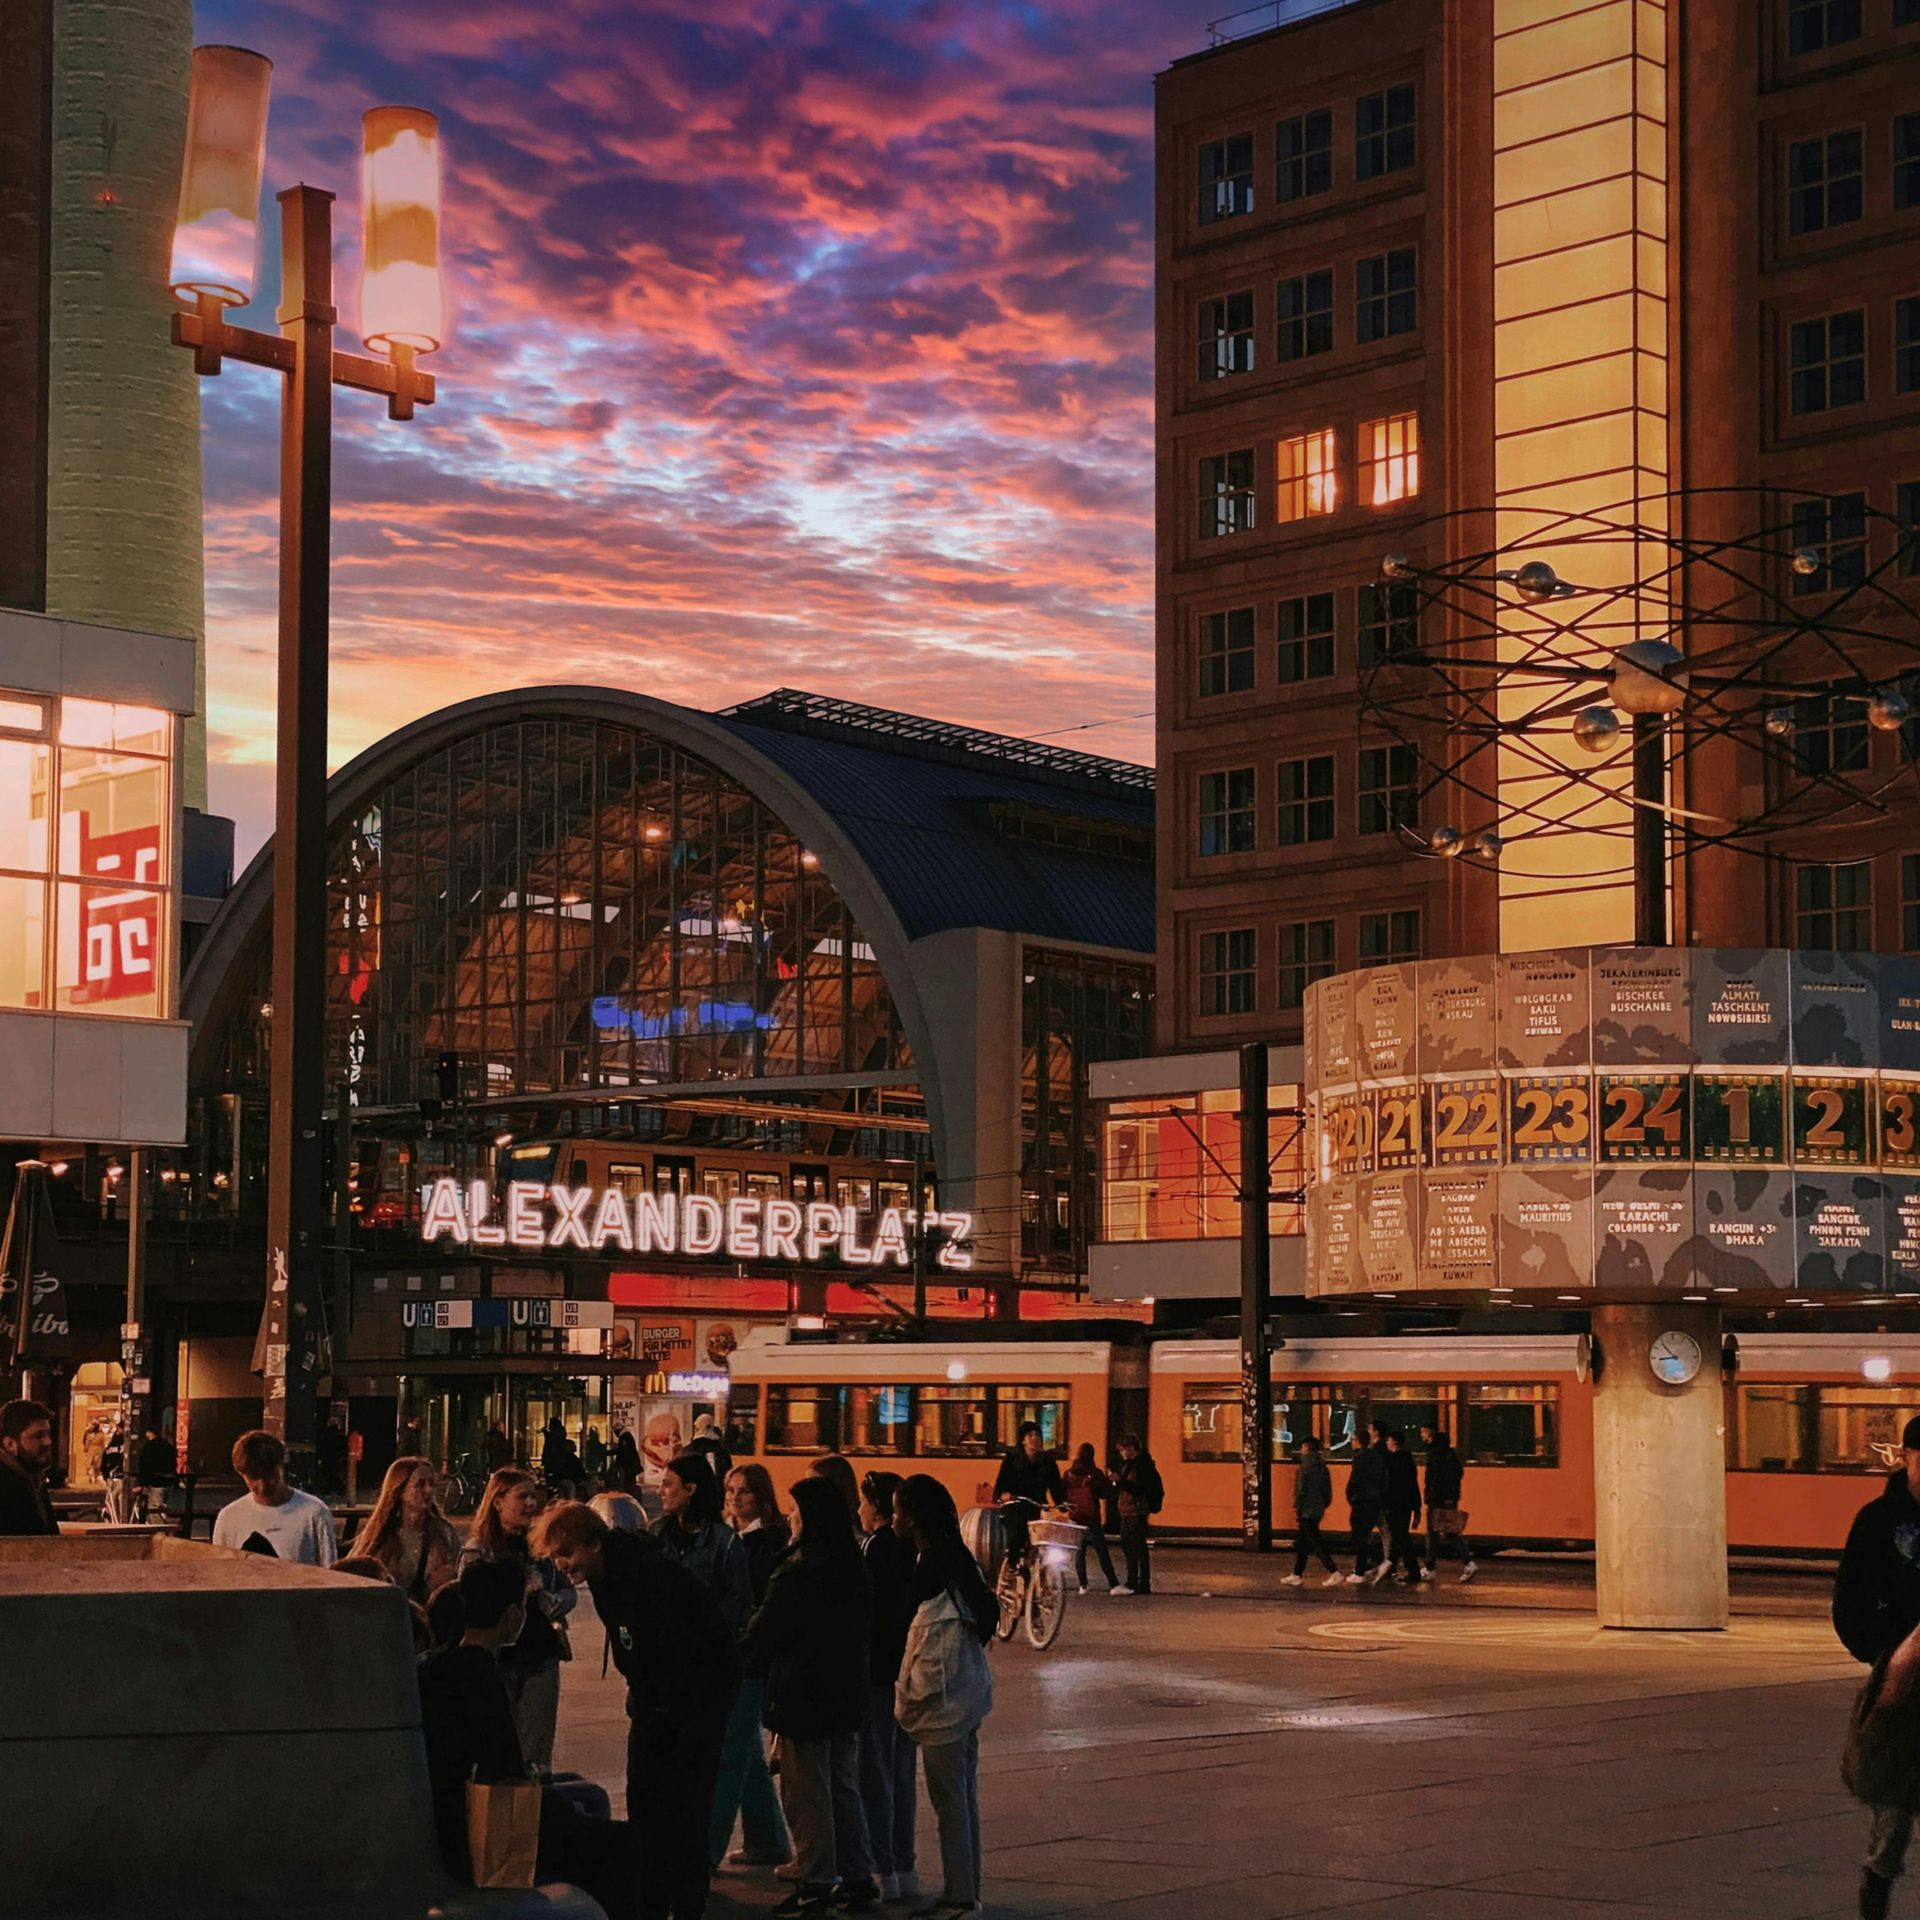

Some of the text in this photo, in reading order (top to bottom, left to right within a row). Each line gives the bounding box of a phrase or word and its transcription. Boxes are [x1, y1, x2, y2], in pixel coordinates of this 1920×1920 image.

[1600, 969, 1681, 978] JEKATERINBURG
[1432, 987, 1479, 998] URMANSK
[1616, 991, 1665, 1000] BISCHKEK
[1721, 991, 1760, 1000] ALMATY
[1514, 993, 1572, 1004] WOLGOGRAD
[1530, 1004, 1556, 1015] BAKU
[1610, 1002, 1672, 1012] DUSCHANBE
[1712, 1003, 1770, 1012] TASCHKENT
[1529, 1016, 1558, 1026] TIFLIS
[1381, 1099, 1421, 1153] 21
[1436, 1092, 1498, 1148] 22
[1515, 1088, 1588, 1144] 23
[1604, 1087, 1682, 1142] 24
[1721, 1088, 1750, 1142] 1
[1807, 1090, 1844, 1145] 2
[1886, 1095, 1914, 1150] 3
[1520, 1212, 1572, 1223] MAURITIUS
[1619, 1212, 1669, 1222] KARACHI
[1818, 1214, 1860, 1224] BANGKOK
[1459, 1226, 1487, 1235] ABEBA
[1608, 1223, 1654, 1233] COLOMBO
[1710, 1224, 1754, 1234] RANGUN
[1809, 1226, 1870, 1236] PHNOM PENH
[1430, 1237, 1487, 1248] MOADISCHU
[1726, 1235, 1764, 1245] DHAKA
[1818, 1237, 1861, 1247] JAKARTA
[1430, 1248, 1487, 1258] DAESSALAM
[1443, 1271, 1474, 1280] KUWAIT
[404, 1304, 416, 1327] U
[513, 1300, 528, 1325] U
[642, 1328, 680, 1340] BURGER
